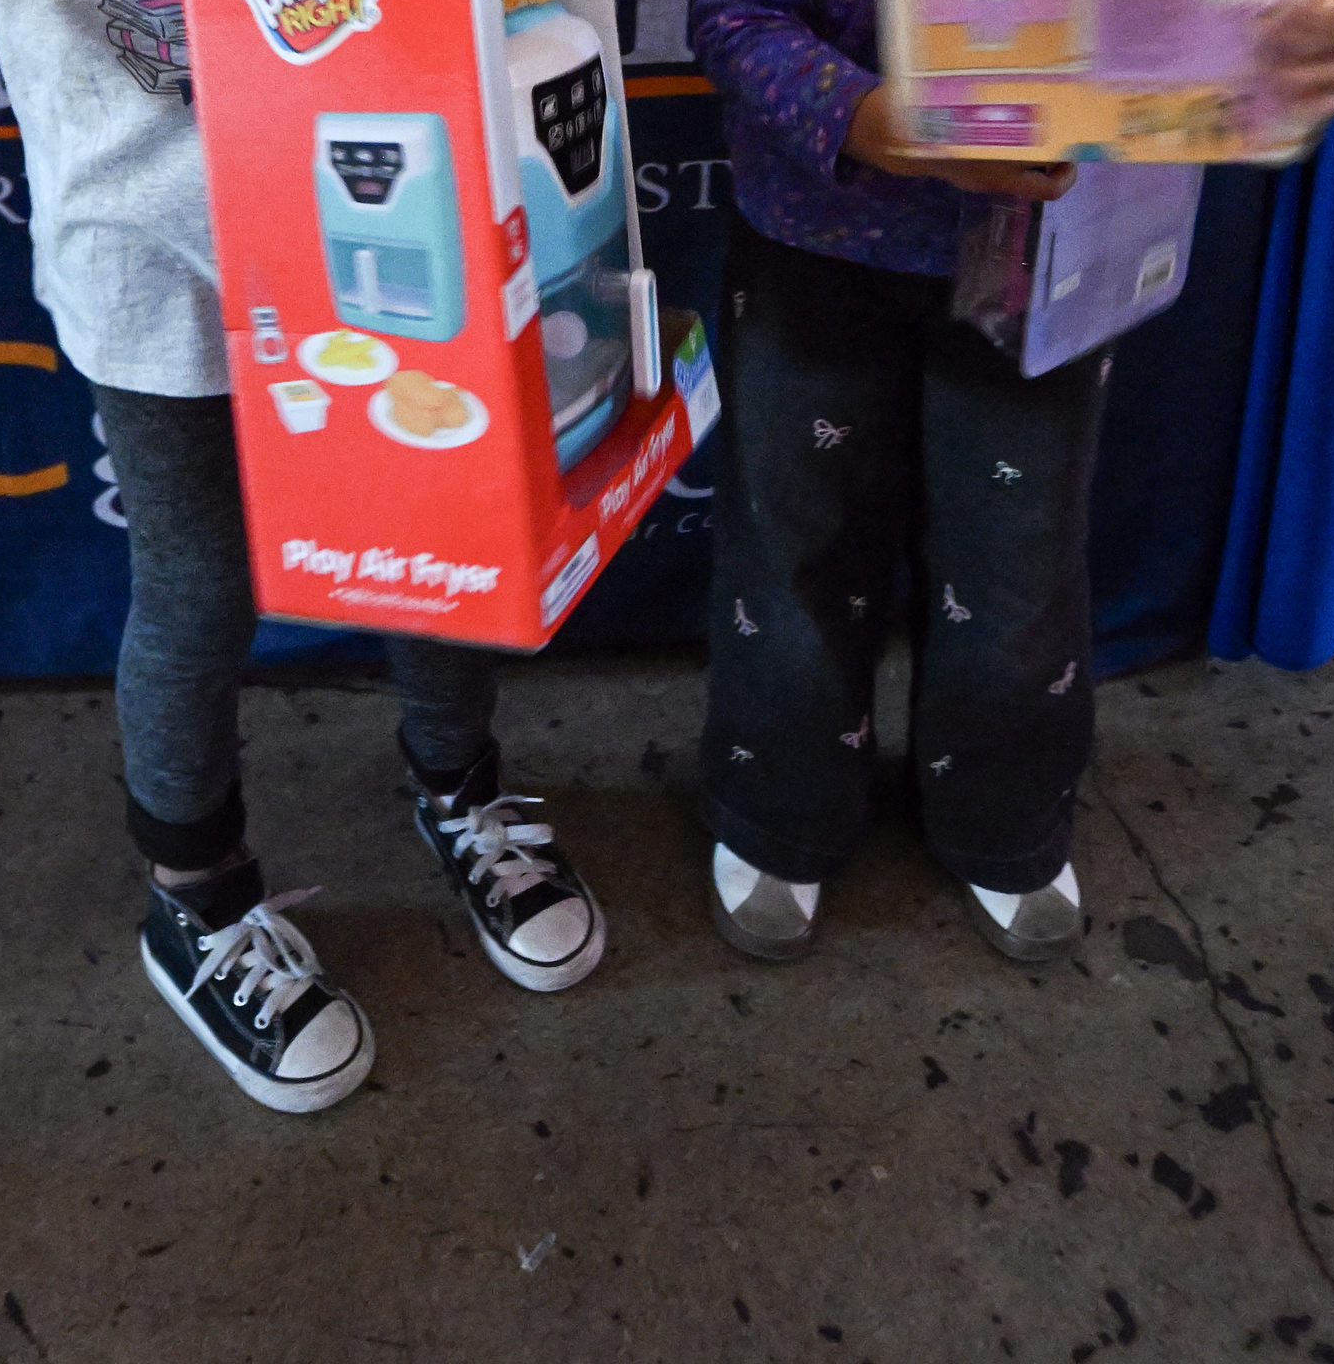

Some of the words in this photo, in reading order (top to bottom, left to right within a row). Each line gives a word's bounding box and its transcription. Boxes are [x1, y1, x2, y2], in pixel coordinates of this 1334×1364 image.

[282, 538, 356, 584] Play
[357, 547, 409, 583] Air
[410, 552, 502, 598] Fryer
